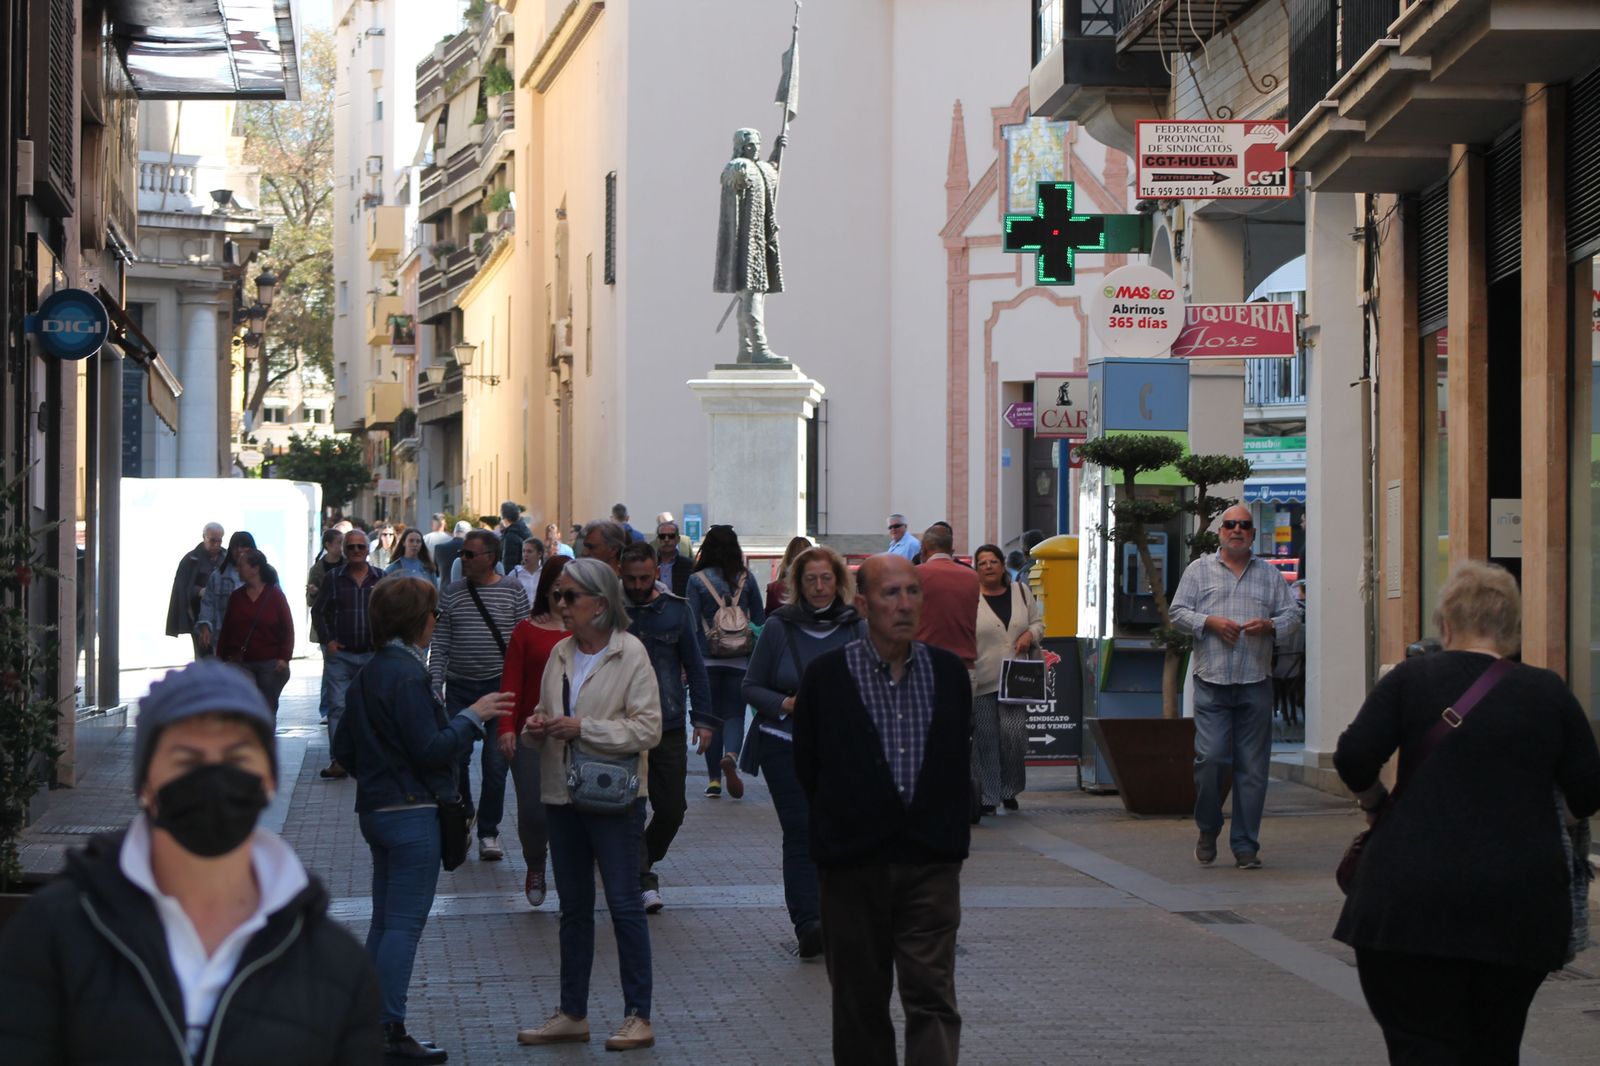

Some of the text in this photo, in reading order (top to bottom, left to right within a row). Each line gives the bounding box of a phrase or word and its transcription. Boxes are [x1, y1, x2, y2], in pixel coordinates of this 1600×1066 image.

[1155, 125, 1225, 134] FEDERACION
[1157, 134, 1223, 143] PROVINCIAL
[1148, 144, 1233, 153] DE SINDICATOS
[1145, 156, 1235, 167] CGT-HUELVA
[1247, 171, 1284, 185] CGT
[1142, 187, 1155, 196] TLF.
[1158, 187, 1172, 196] 959
[1175, 187, 1185, 196] 25
[1187, 187, 1196, 196] 01
[1199, 187, 1208, 196] 21
[1217, 187, 1232, 196] FAX
[1234, 187, 1249, 196] 959
[1251, 187, 1261, 196] 25
[1263, 187, 1272, 196] 01
[1275, 187, 1285, 196] 17
[1115, 286, 1175, 300] MAS&GO
[1112, 304, 1165, 315] Abrimos
[42, 319, 101, 334] DIGI
[1108, 316, 1168, 329] 365 días
